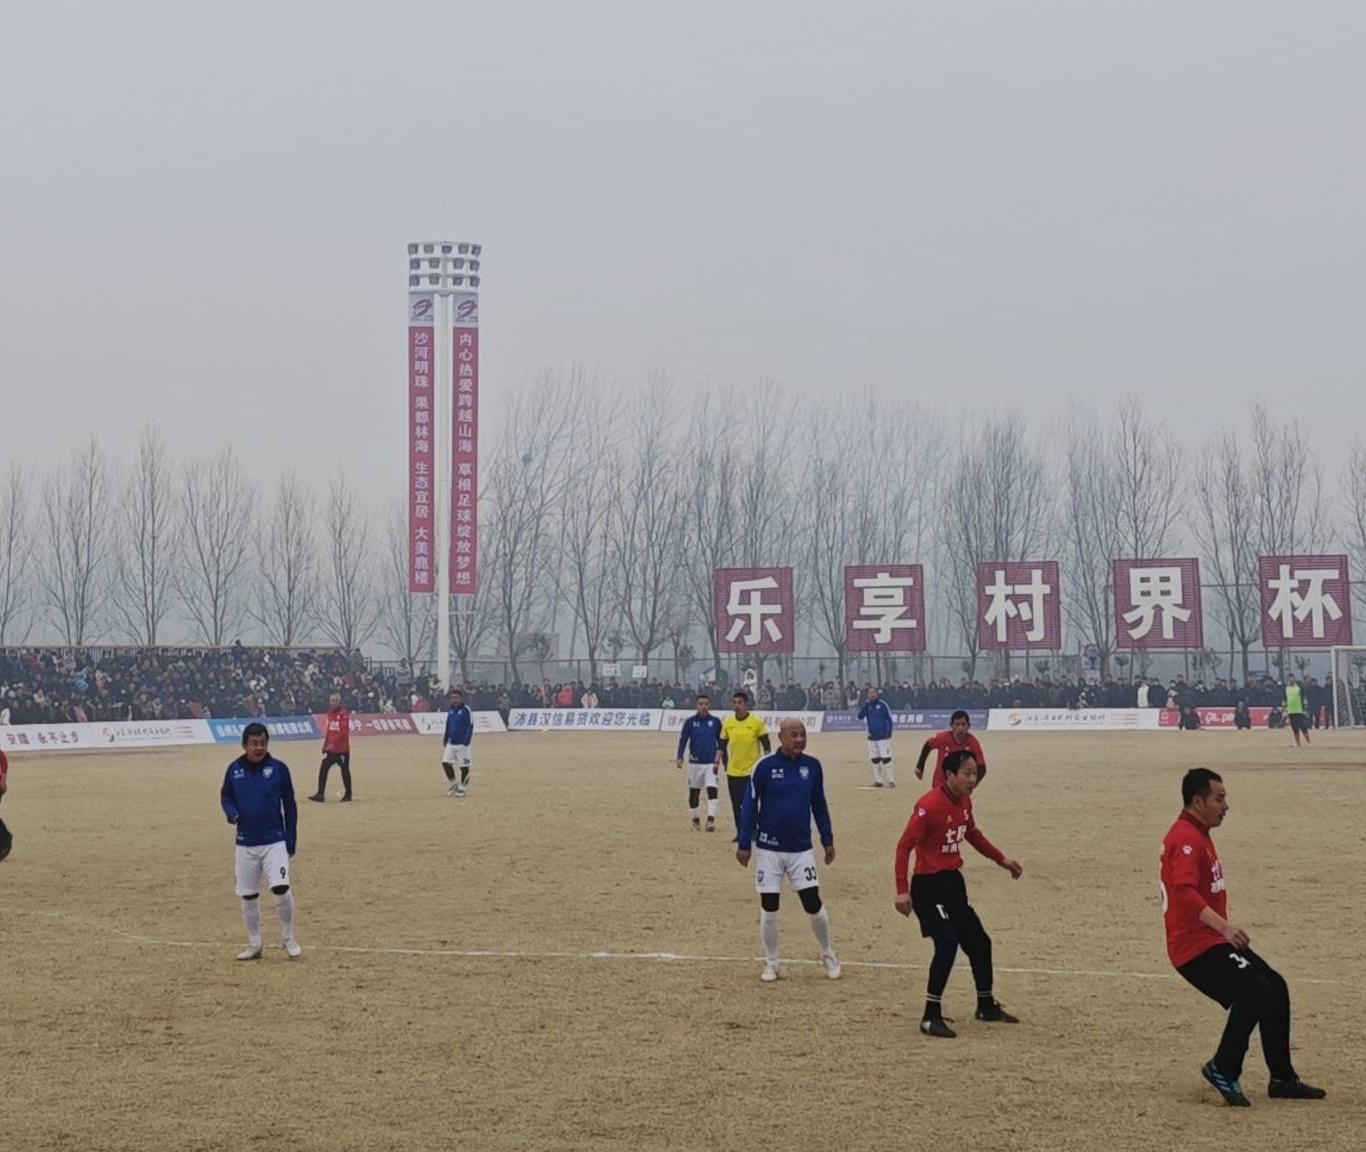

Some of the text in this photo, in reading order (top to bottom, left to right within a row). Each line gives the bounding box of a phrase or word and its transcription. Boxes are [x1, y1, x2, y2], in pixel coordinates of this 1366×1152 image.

[725, 564, 1343, 646] 乐享村界杯
